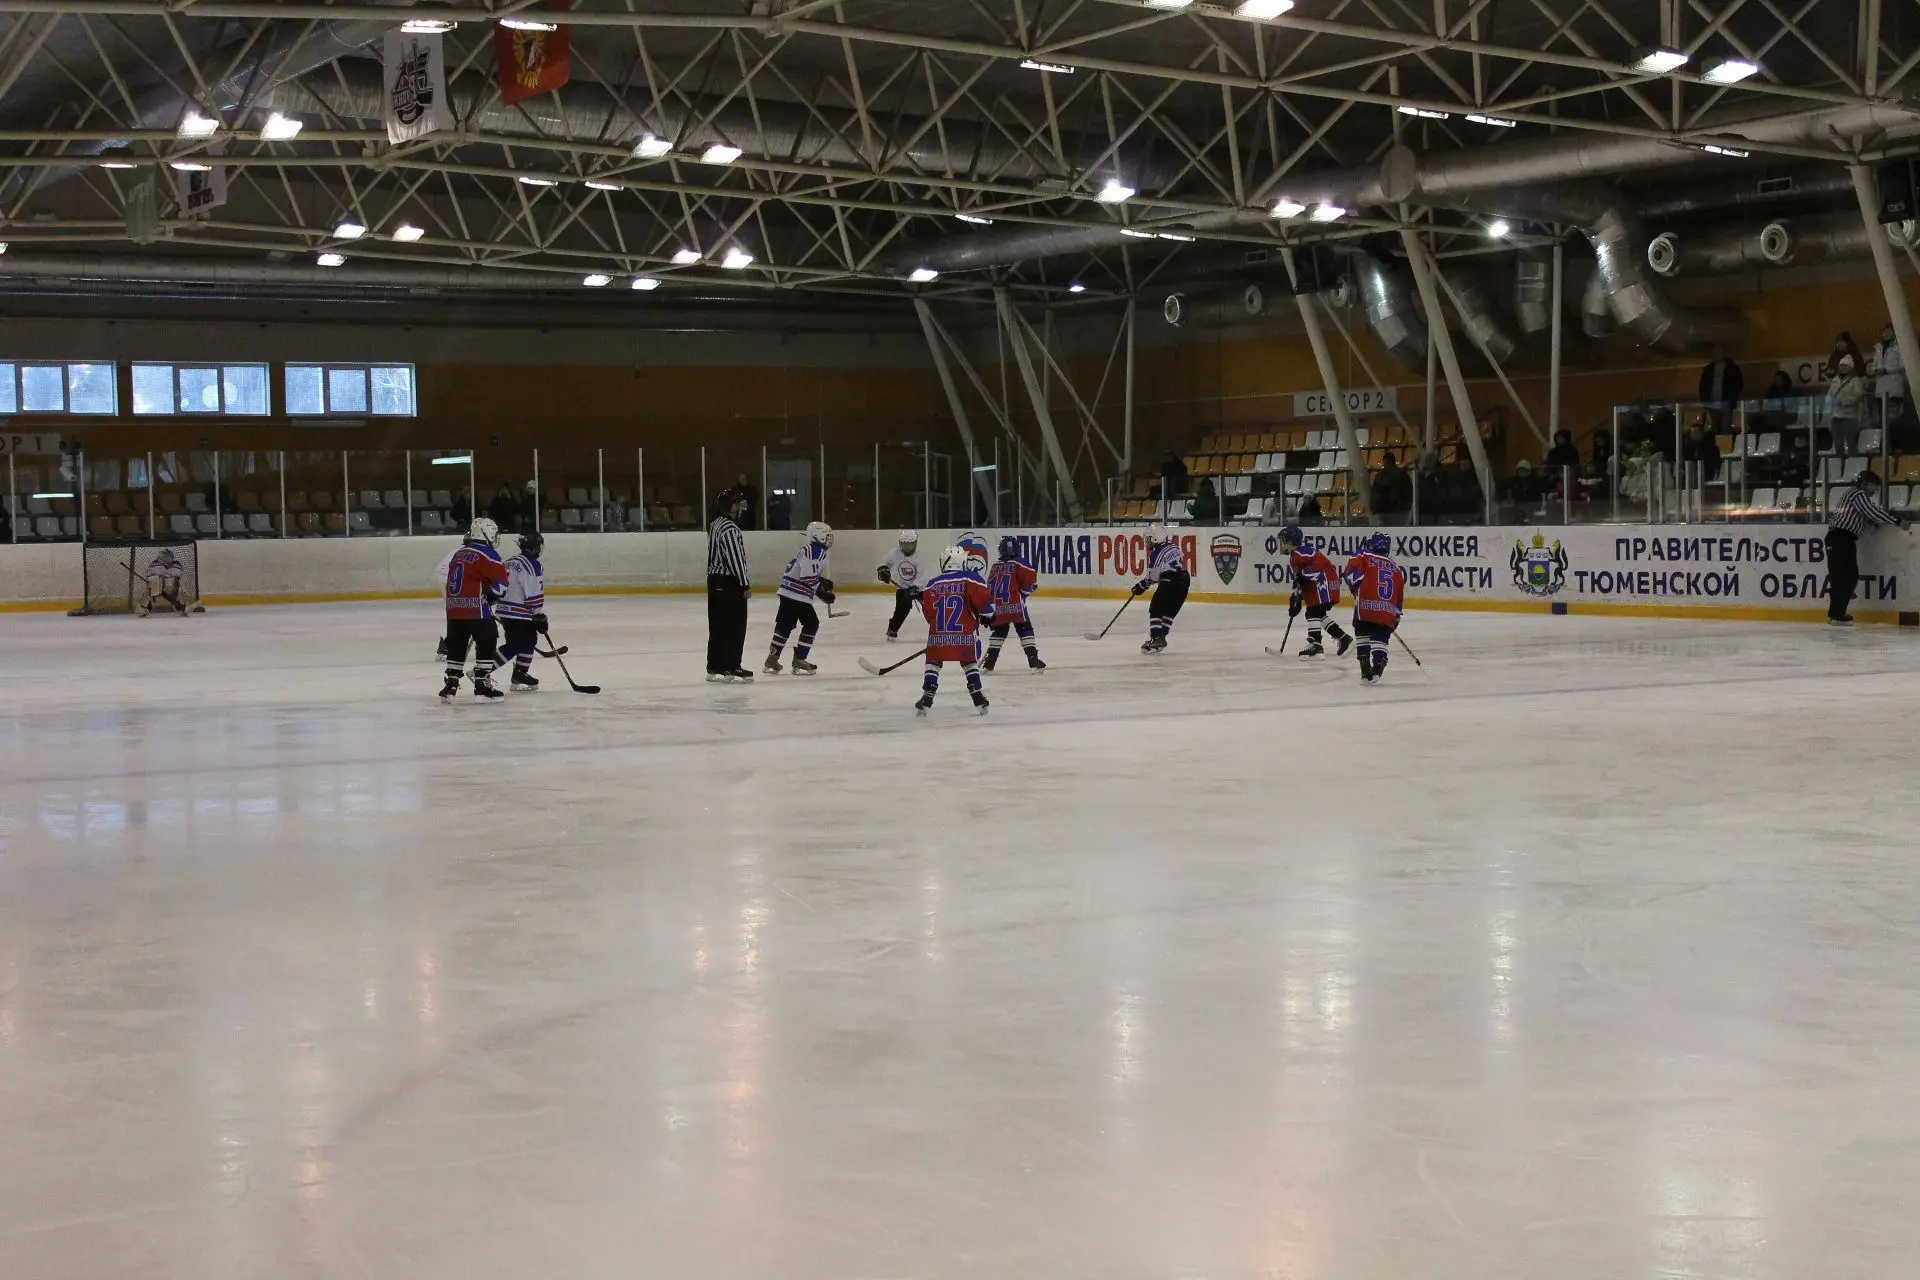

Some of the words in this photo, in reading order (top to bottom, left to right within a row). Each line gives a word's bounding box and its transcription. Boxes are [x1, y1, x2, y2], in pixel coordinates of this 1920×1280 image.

[1306, 393, 1370, 413] СЕОР
[1376, 391, 1384, 409] 2
[1002, 535, 1091, 575] ДИНАЯ
[1099, 534, 1197, 577] РОСЯ
[1396, 535, 1478, 557] ХОККЕЯ
[1615, 537, 1826, 563] ПРАВИТЕЛЬСТВ
[988, 573, 1011, 604] 14
[1377, 568, 1395, 601] 5
[1574, 565, 1740, 597] ТЮМЕНСКОЙ
[1760, 572, 1897, 601] ОБЛАТИ
[933, 595, 964, 633] 12
